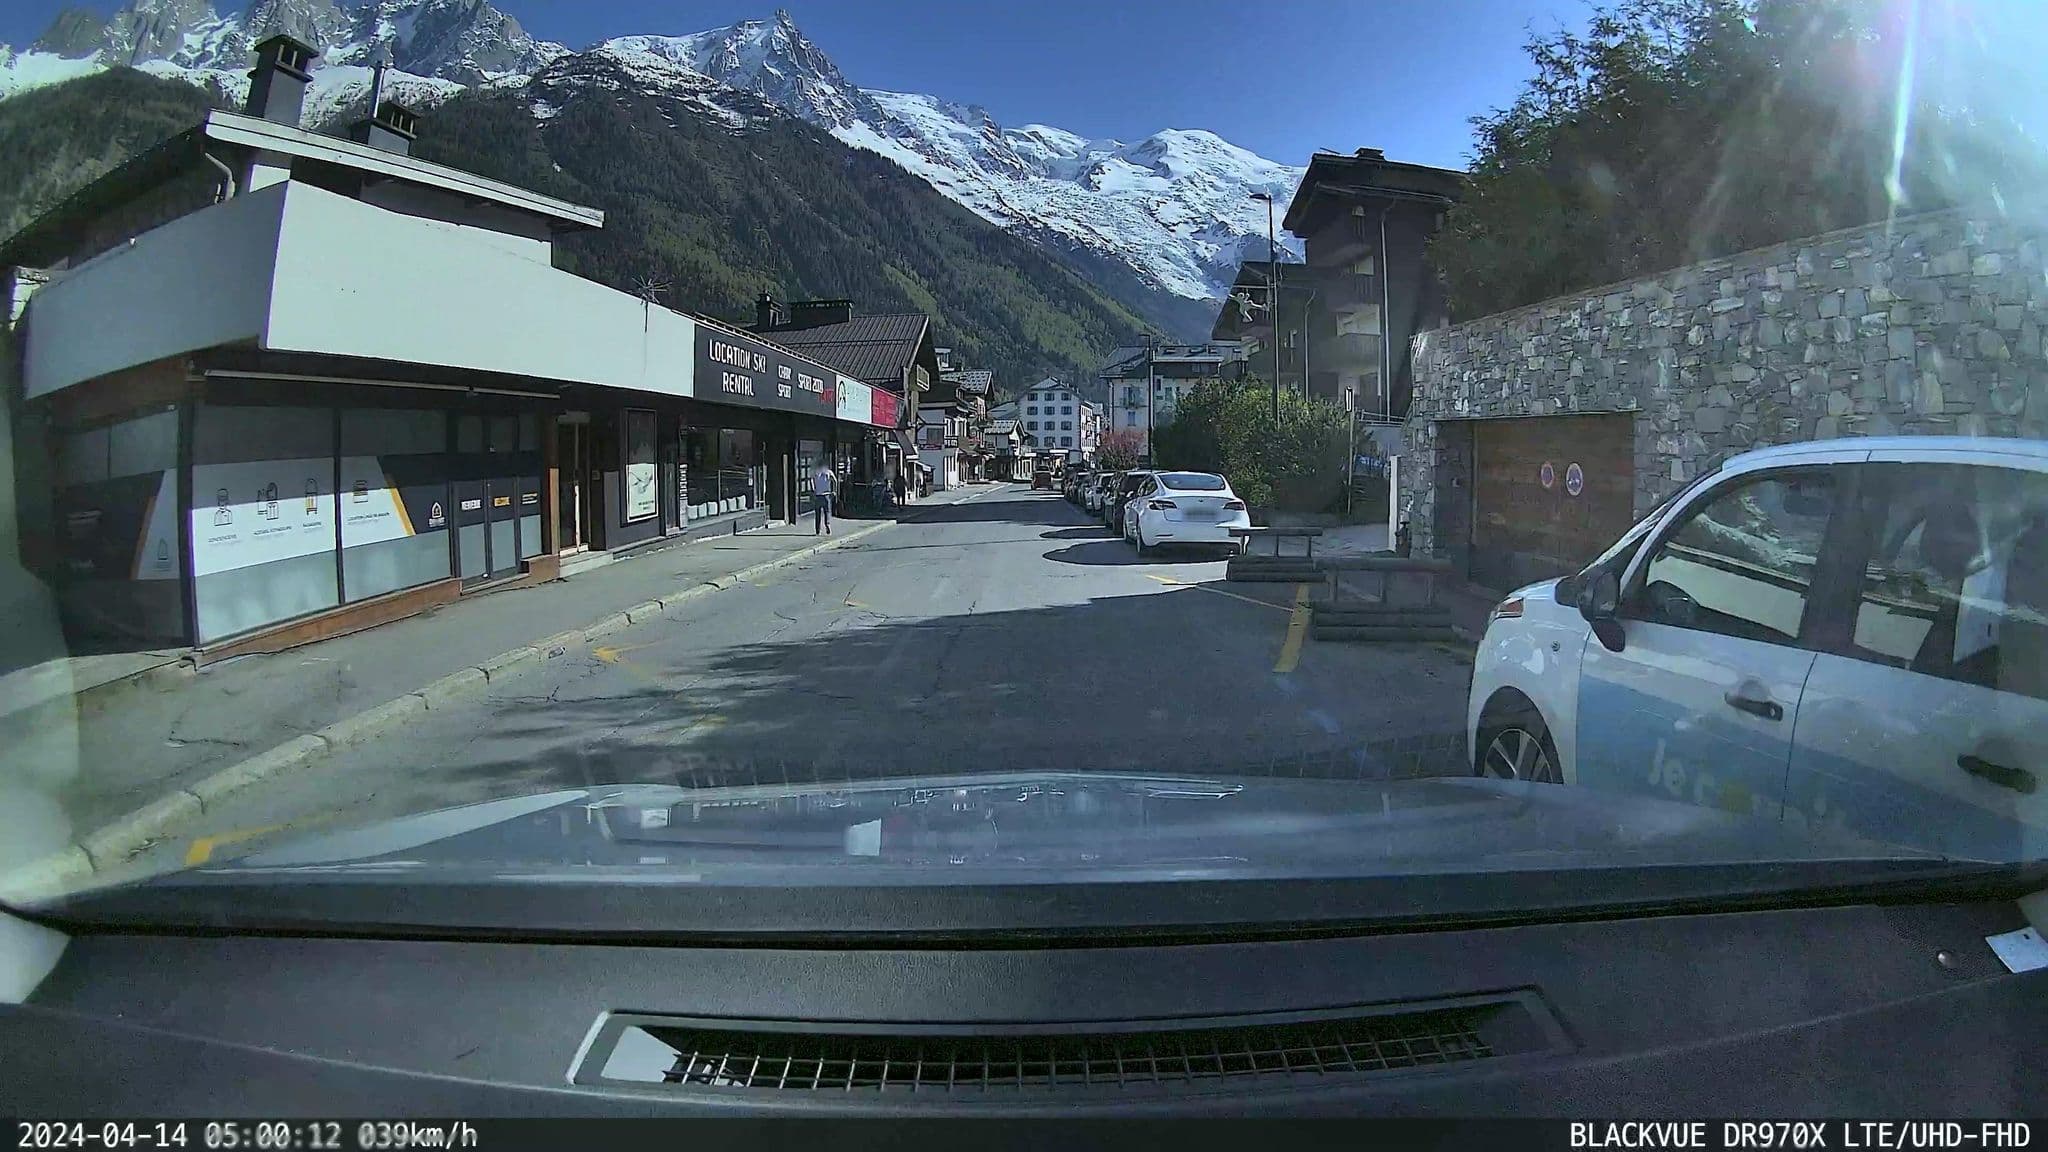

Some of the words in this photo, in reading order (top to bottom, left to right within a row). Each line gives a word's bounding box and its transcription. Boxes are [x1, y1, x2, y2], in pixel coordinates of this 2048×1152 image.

[709, 339, 750, 369] LOCATION
[753, 354, 766, 373] SKI
[722, 372, 754, 396] RENTAL
